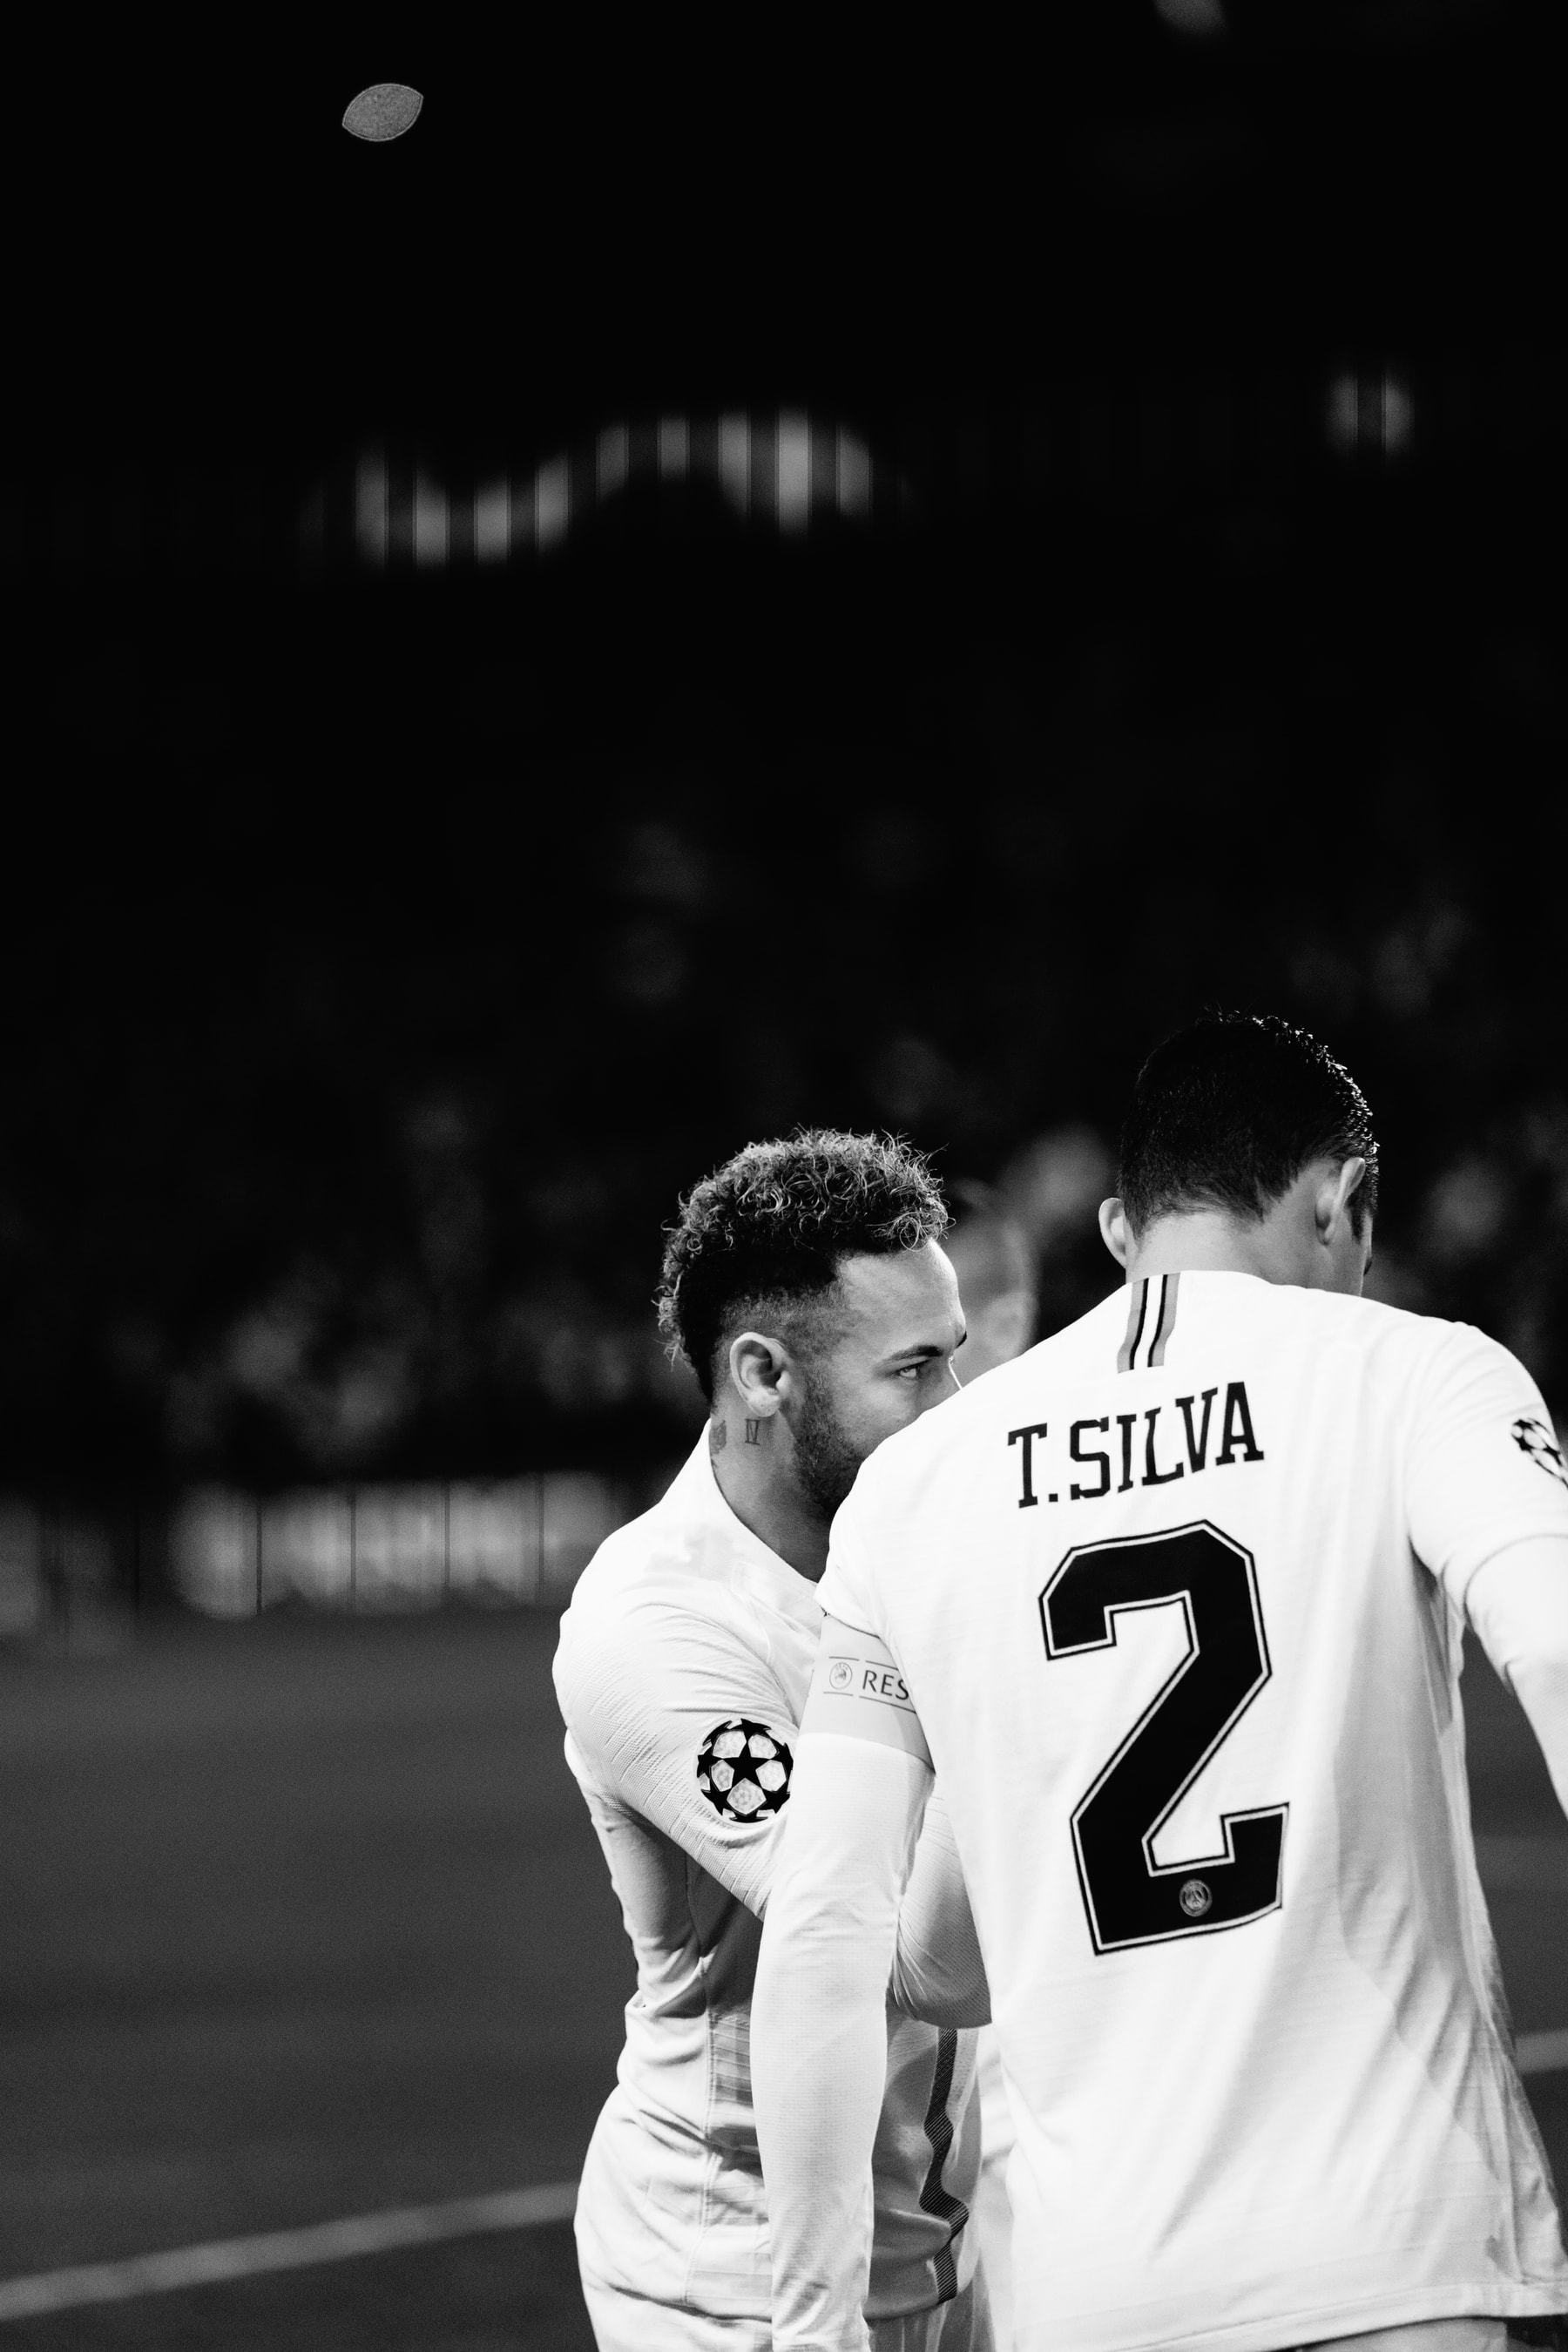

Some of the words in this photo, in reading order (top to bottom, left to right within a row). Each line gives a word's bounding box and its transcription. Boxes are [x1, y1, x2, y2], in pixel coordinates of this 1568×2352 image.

[1007, 1382, 1264, 1509] T.SILVA
[862, 1669, 909, 1700] RES
[1038, 1519, 1289, 1957] 2
